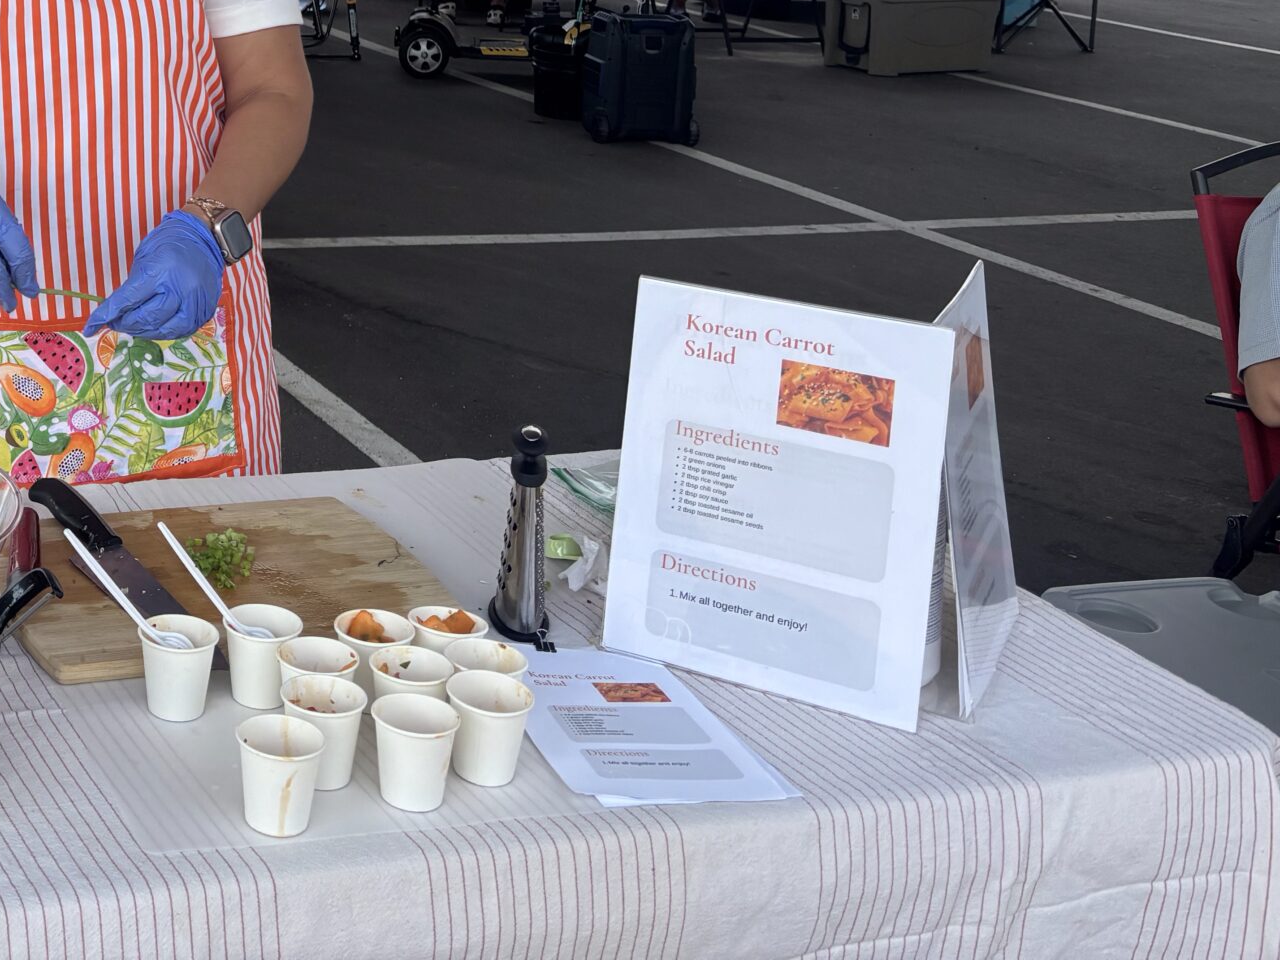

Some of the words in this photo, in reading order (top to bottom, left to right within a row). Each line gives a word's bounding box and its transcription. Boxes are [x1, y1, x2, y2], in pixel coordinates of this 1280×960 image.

[686, 313, 758, 342] Korean
[765, 328, 836, 356] Carrot
[684, 339, 736, 364] Salad
[674, 419, 780, 456] Ingredients
[688, 458, 705, 466] green
[706, 462, 726, 470] onions
[694, 450, 715, 459] carrots
[716, 455, 737, 464] peeled
[750, 462, 773, 472] ribbons
[686, 474, 699, 482] tbsp
[712, 480, 735, 489] vinegar
[701, 469, 720, 478] grated
[721, 472, 738, 481] garlic
[685, 482, 698, 490] tbsp
[712, 488, 727, 496] crisp
[684, 490, 698, 498] tbsp
[710, 497, 729, 505] sauce
[683, 499, 697, 507] tbsp
[697, 502, 720, 512] toasted
[721, 507, 745, 517] sesame
[682, 507, 696, 515] tbsp
[696, 510, 719, 520] toasted
[720, 515, 744, 525] sesame
[745, 521, 764, 530] seeds
[661, 553, 757, 591] Directions
[668, 588, 678, 598] 1.
[679, 590, 697, 603] Mix
[698, 595, 710, 606] all
[712, 599, 754, 618] together
[755, 610, 775, 623] and
[777, 616, 809, 633] enjoy!
[527, 669, 572, 681] Korean
[575, 673, 617, 681] Carrot
[533, 679, 568, 687] Salad
[552, 704, 618, 714] Ingredients
[584, 748, 651, 757] Directions
